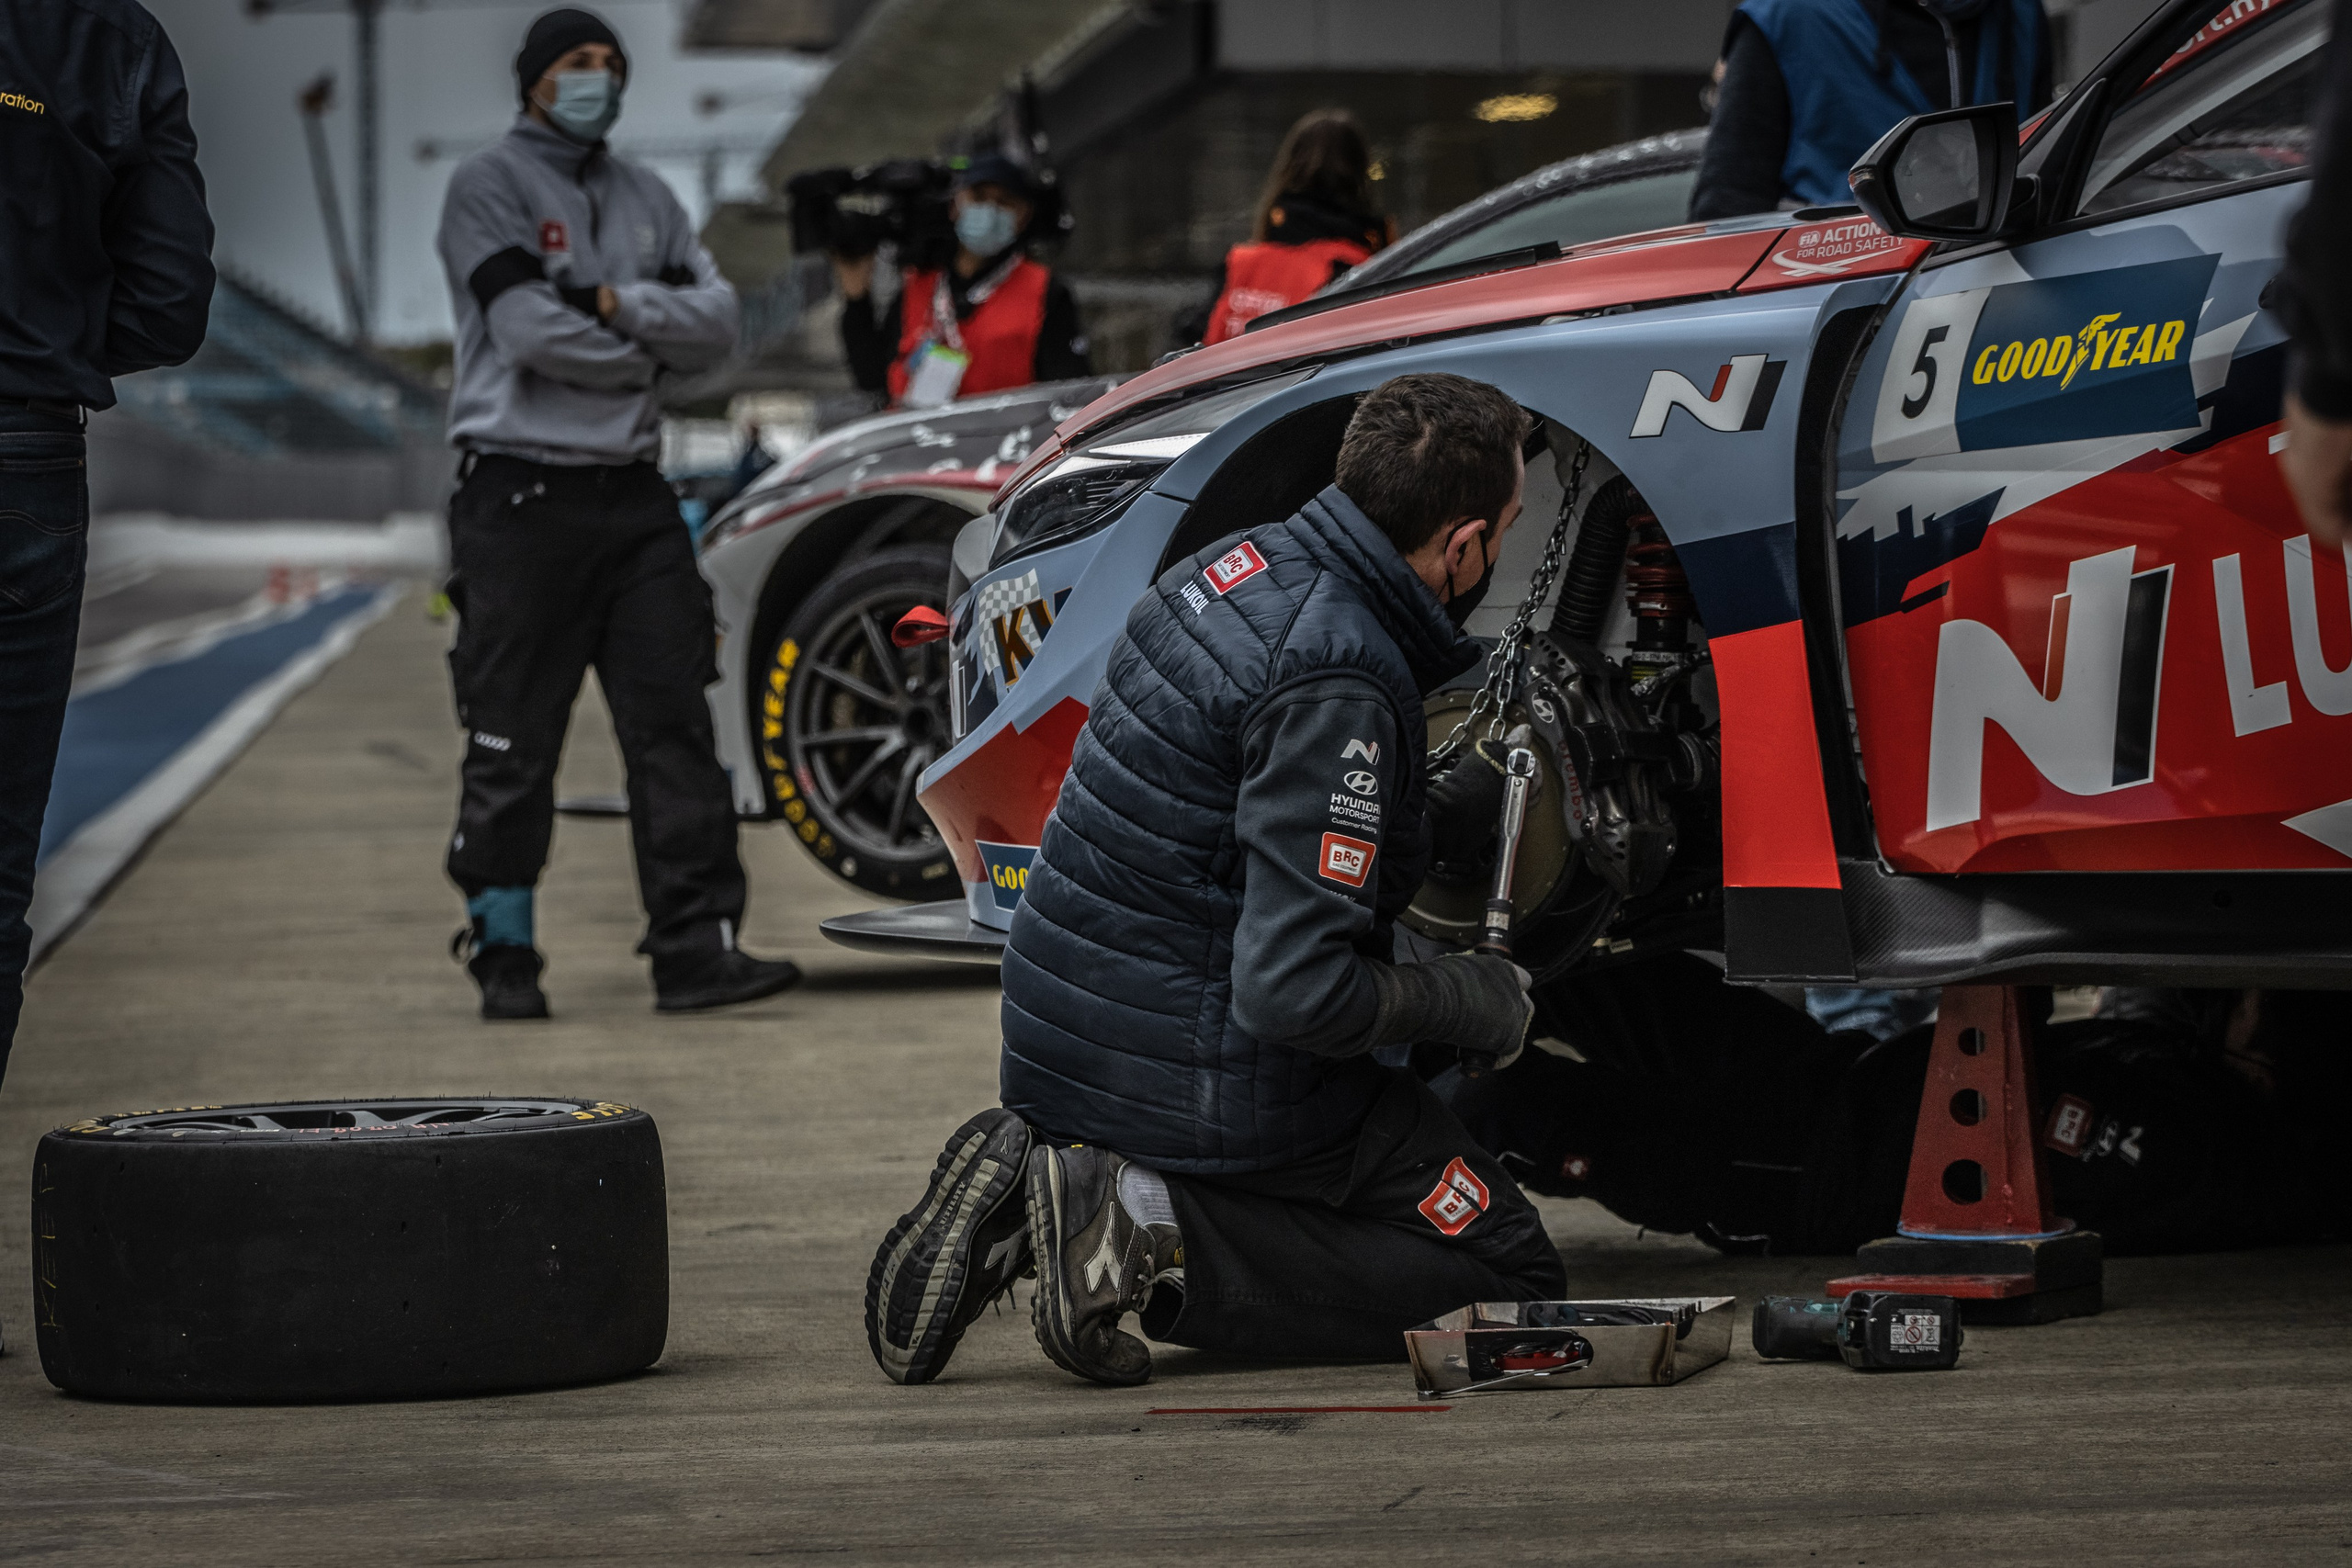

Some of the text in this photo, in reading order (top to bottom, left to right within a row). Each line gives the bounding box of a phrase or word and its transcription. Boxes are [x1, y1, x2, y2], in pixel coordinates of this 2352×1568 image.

[0, 92, 45, 115] ration
[1800, 221, 1882, 245] FIA ACTION
[1796, 236, 1905, 259] FOR ROAD SAFETY
[1901, 324, 1951, 420] 5
[1223, 553, 1244, 574] BRC
[1180, 580, 1209, 615] LUKOIL
[1329, 805, 1380, 825] MOTORSPORT
[1331, 817, 1377, 834] Customer Racing
[1333, 851, 1360, 867] BRC
[939, 1181, 966, 1225] UTILITY
[1443, 1181, 1470, 1214] BRC
[39, 1163, 63, 1330] KEEP
